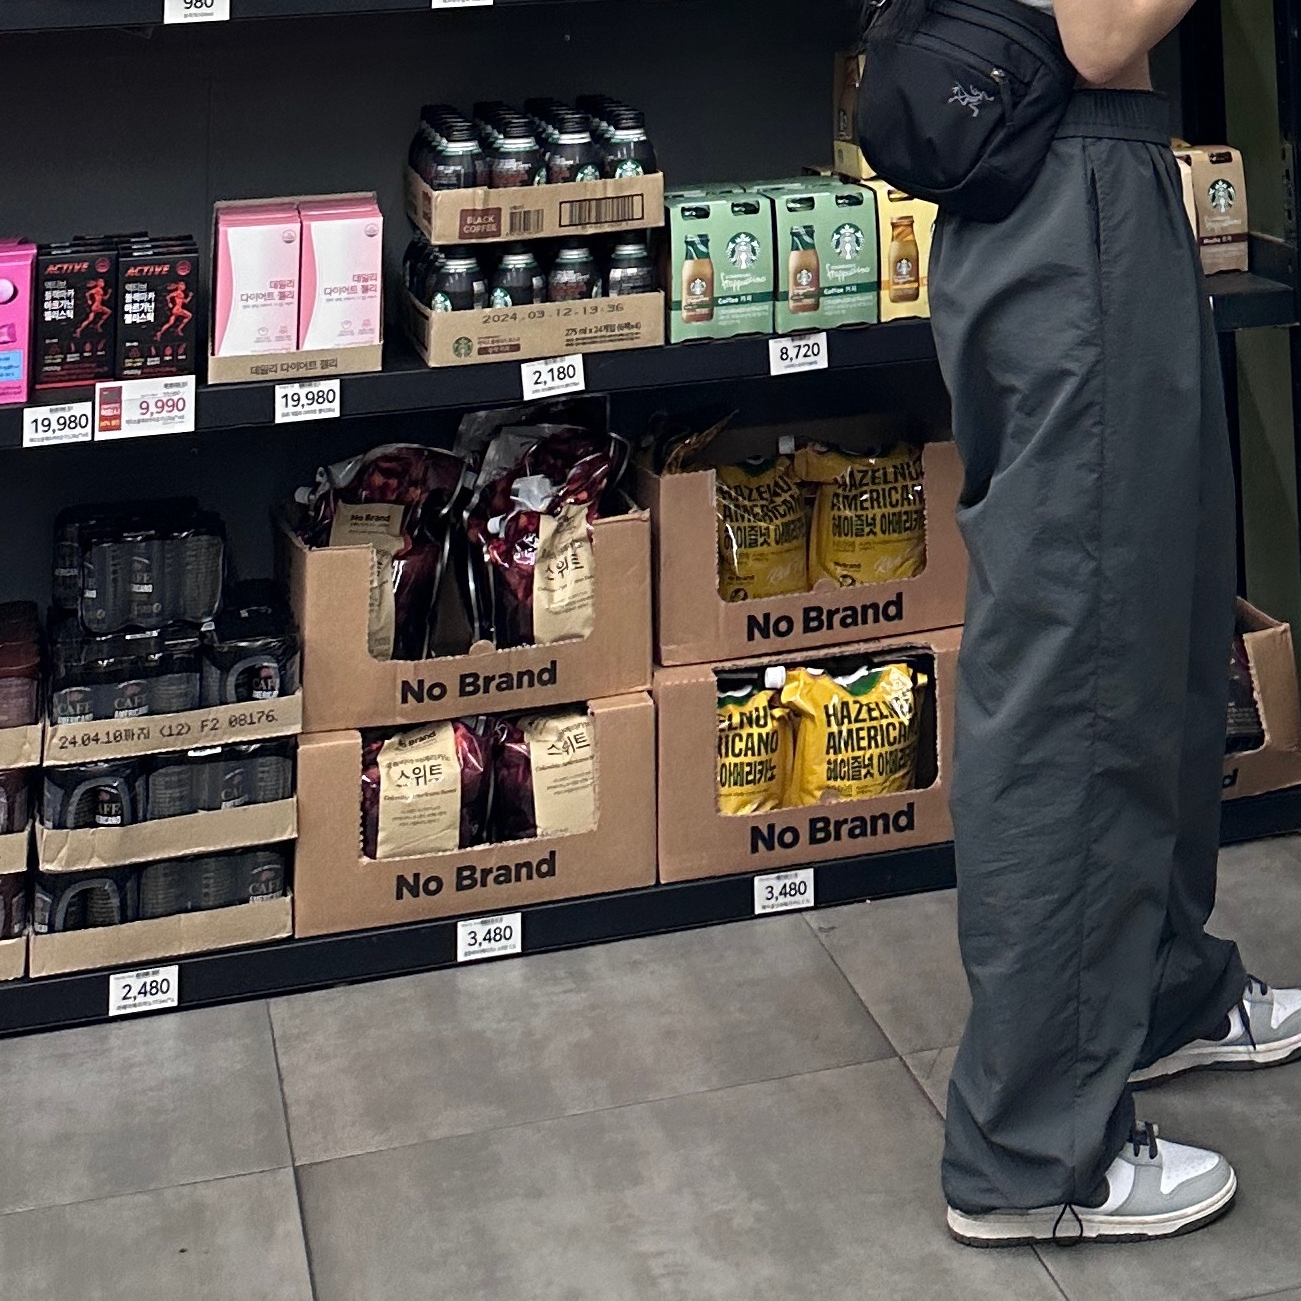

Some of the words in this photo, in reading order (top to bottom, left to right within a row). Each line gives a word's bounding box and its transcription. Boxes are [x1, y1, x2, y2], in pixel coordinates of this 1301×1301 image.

[463, 223, 498, 234] COFFEE
[466, 214, 496, 225] BLACK
[45, 262, 90, 275] ACTIVE
[125, 264, 170, 277] ACTIVE
[779, 341, 821, 364] 8,720
[532, 363, 577, 387] 2,180
[139, 397, 187, 418] 9,990
[280, 388, 337, 411] 19,980
[30, 413, 89, 435] 19,980
[746, 611, 795, 642] No
[802, 591, 904, 635] Brand
[400, 677, 447, 705] No
[458, 660, 558, 698] Brand
[159, 722, 192, 739] (12)
[749, 819, 800, 854] No
[808, 802, 916, 848] Brand
[395, 869, 443, 902] No
[454, 851, 557, 894] Brand
[764, 880, 809, 902] 3,480
[467, 924, 514, 948] 3,480
[121, 978, 171, 1001] 2,480
